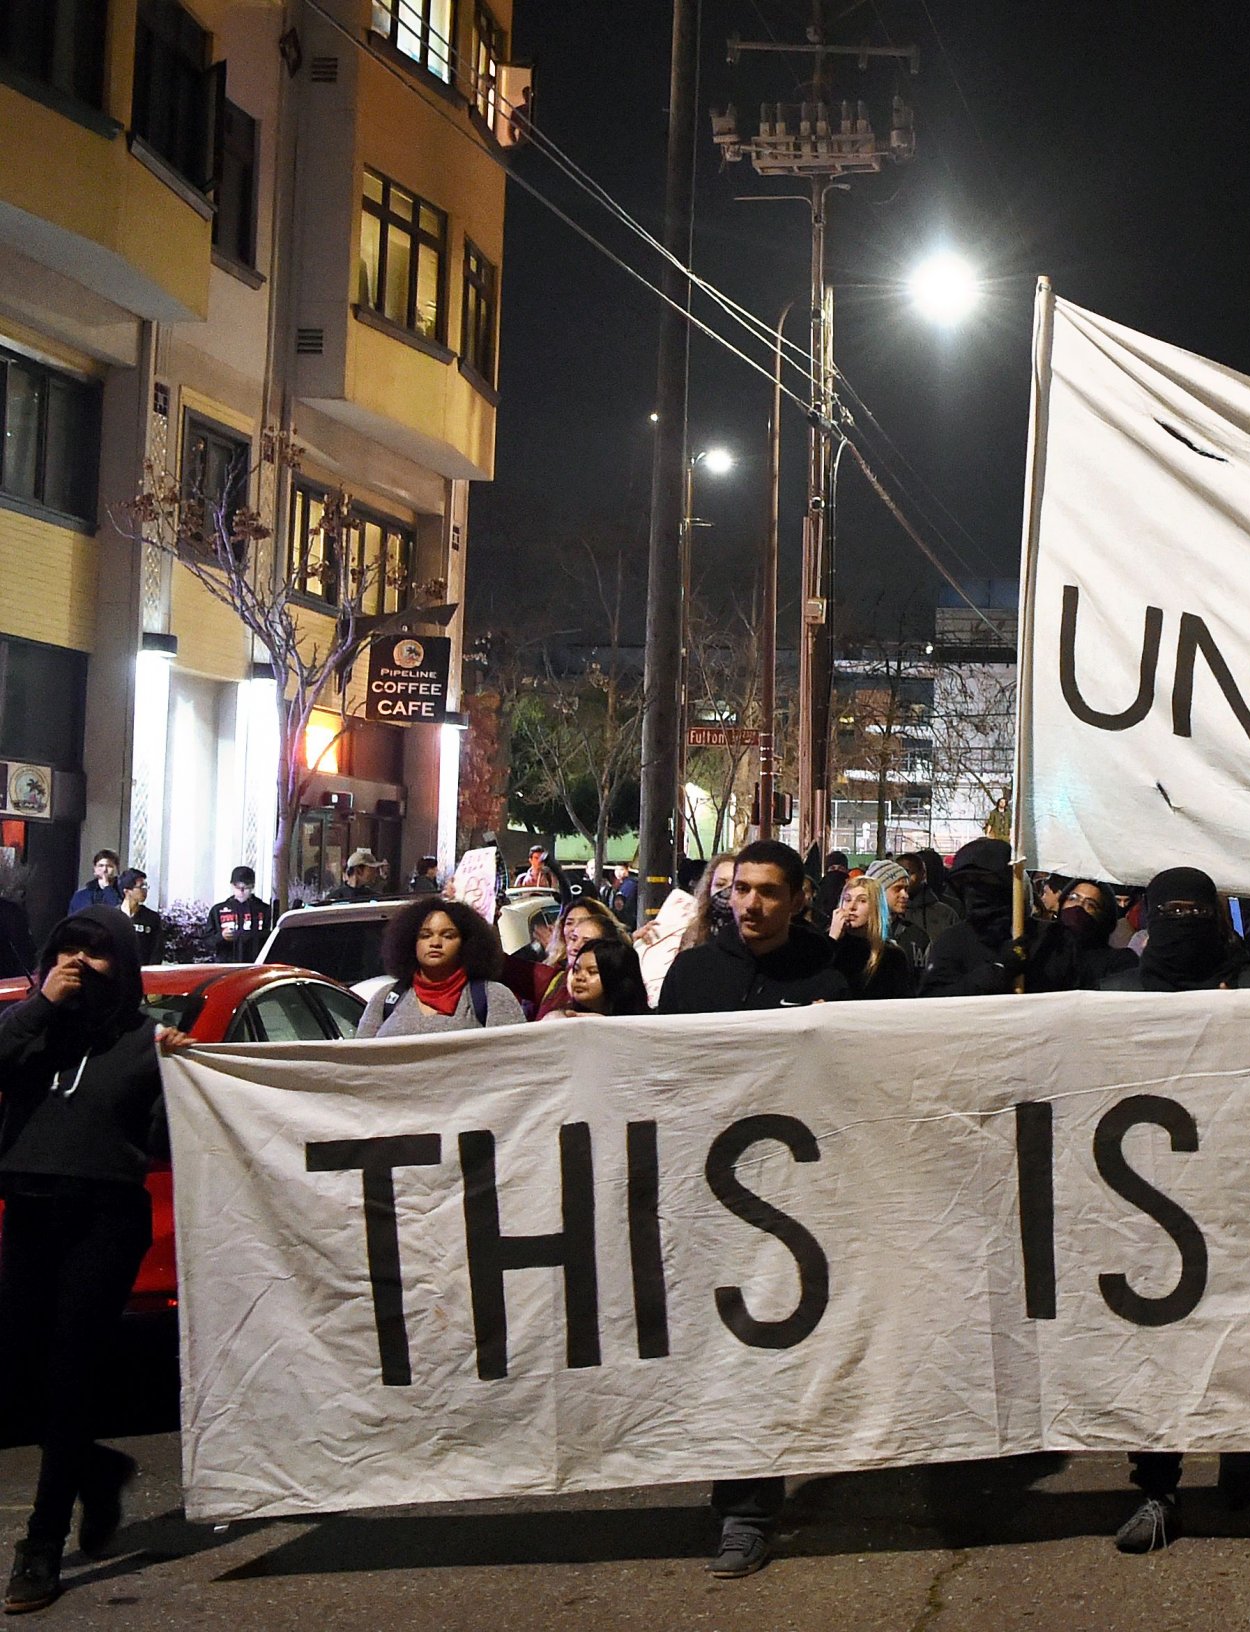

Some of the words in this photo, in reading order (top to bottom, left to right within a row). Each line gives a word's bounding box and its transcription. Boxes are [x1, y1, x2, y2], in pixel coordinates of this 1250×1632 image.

[380, 668, 437, 679] PIPELINE
[371, 681, 442, 696] COFFEE
[377, 699, 435, 717] CAFE
[690, 730, 726, 744] Fulton
[304, 1113, 831, 1387] THIS
[1013, 1093, 1209, 1328] IS
